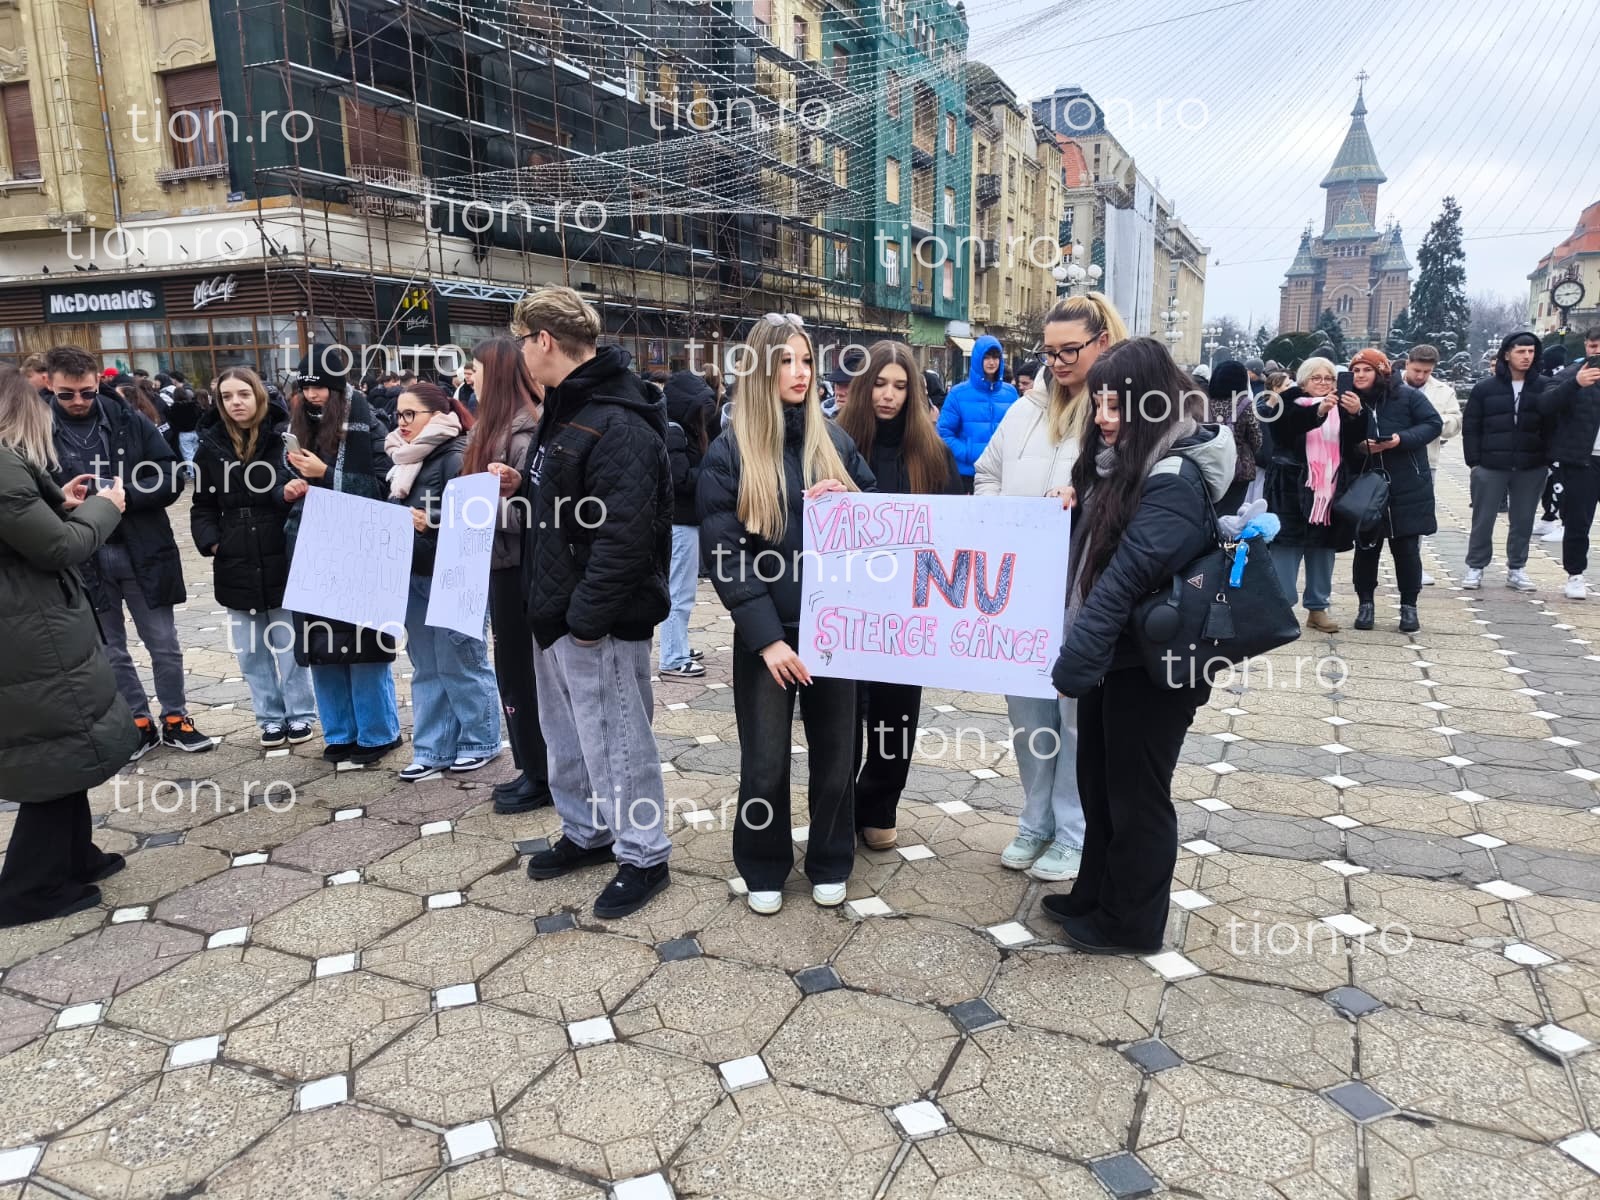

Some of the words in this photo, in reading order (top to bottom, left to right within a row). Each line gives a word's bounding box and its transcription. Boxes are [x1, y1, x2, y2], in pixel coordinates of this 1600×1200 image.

[50, 289, 156, 314] McDonald's
[807, 497, 933, 551] VÂRSTA
[912, 549, 1016, 617] NU
